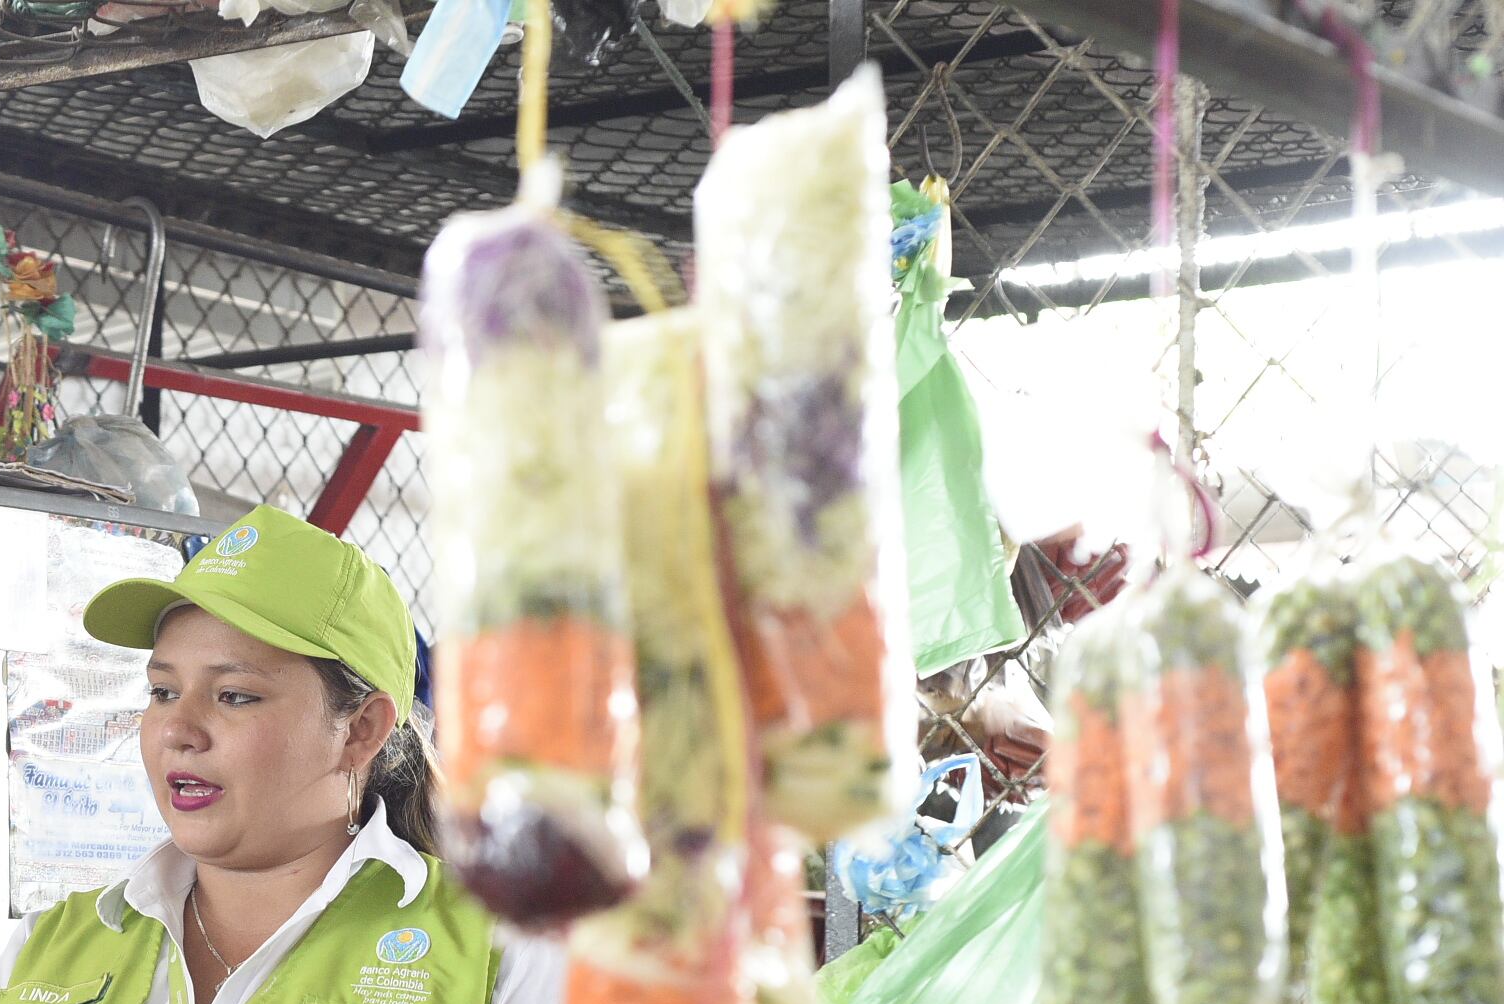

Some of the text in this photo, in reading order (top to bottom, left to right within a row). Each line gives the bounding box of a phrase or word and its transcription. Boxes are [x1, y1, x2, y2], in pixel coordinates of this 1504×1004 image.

[360, 966, 430, 979] Banco Agrario
[360, 975, 424, 990] de Colombia
[19, 987, 70, 1004] LINDA
